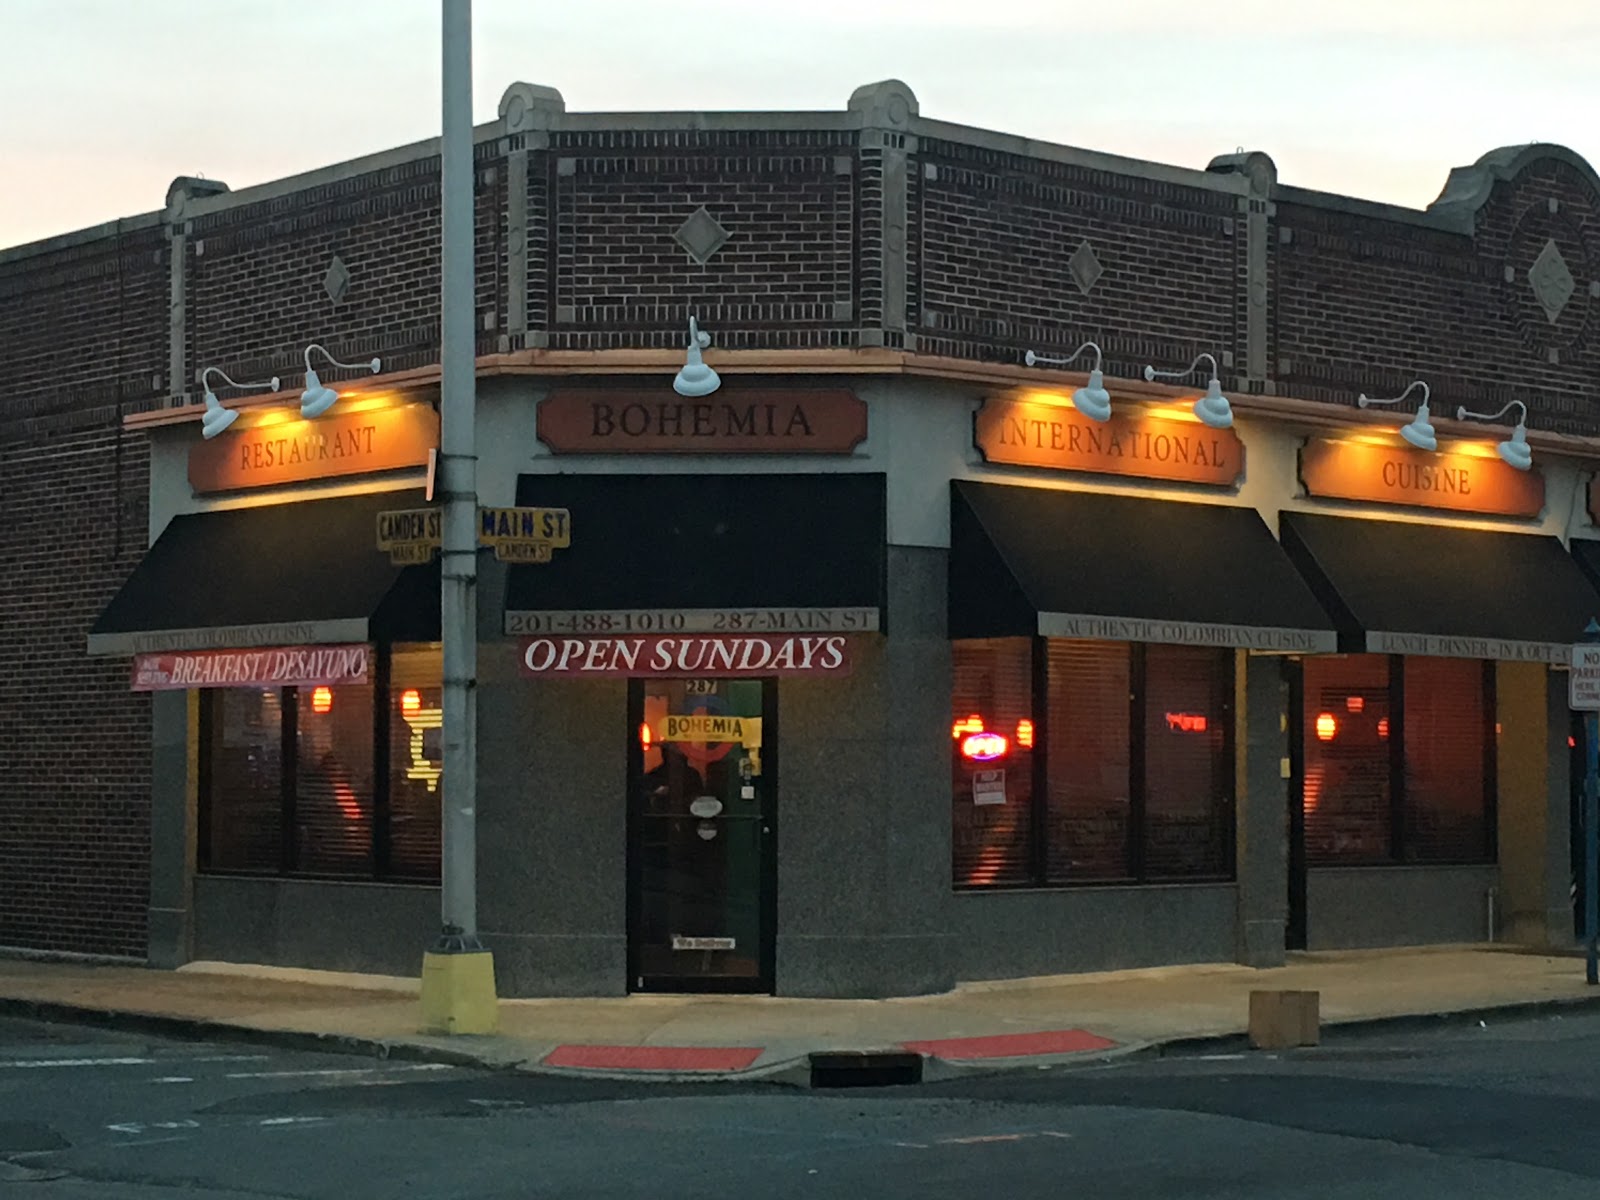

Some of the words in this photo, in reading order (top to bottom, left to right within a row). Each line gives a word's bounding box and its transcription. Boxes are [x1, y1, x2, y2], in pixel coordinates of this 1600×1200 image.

[590, 403, 815, 437] BOHEMIA
[241, 426, 376, 470] RESTAURANT
[999, 416, 1225, 468] INTERNATIONAL
[1382, 460, 1471, 495] CUISINE
[379, 512, 425, 541] CAMDEN
[482, 510, 535, 538] MAIN
[543, 512, 566, 539] ST
[392, 545, 415, 561] MAIN
[417, 544, 429, 559] ST
[499, 543, 536, 559] CAMDEN
[538, 543, 549, 559] ST
[269, 624, 316, 643] CUISINE
[510, 613, 685, 632] 201-488-1010
[841, 610, 873, 629] ST
[1064, 618, 1158, 639] AUTHENTIC
[1161, 624, 1252, 646] COLOMBIAN
[1257, 630, 1317, 649] CUISINE
[525, 639, 646, 672] OPEN
[650, 636, 845, 671] SUNDAYS
[1382, 635, 1428, 653] LUNCH
[1439, 637, 1488, 656] DINNER
[1500, 643, 1511, 658] IN
[1527, 644, 1552, 660] OUT
[1583, 652, 1600, 665] NO
[686, 680, 715, 693] 287
[667, 718, 743, 738] BOHEMIA
